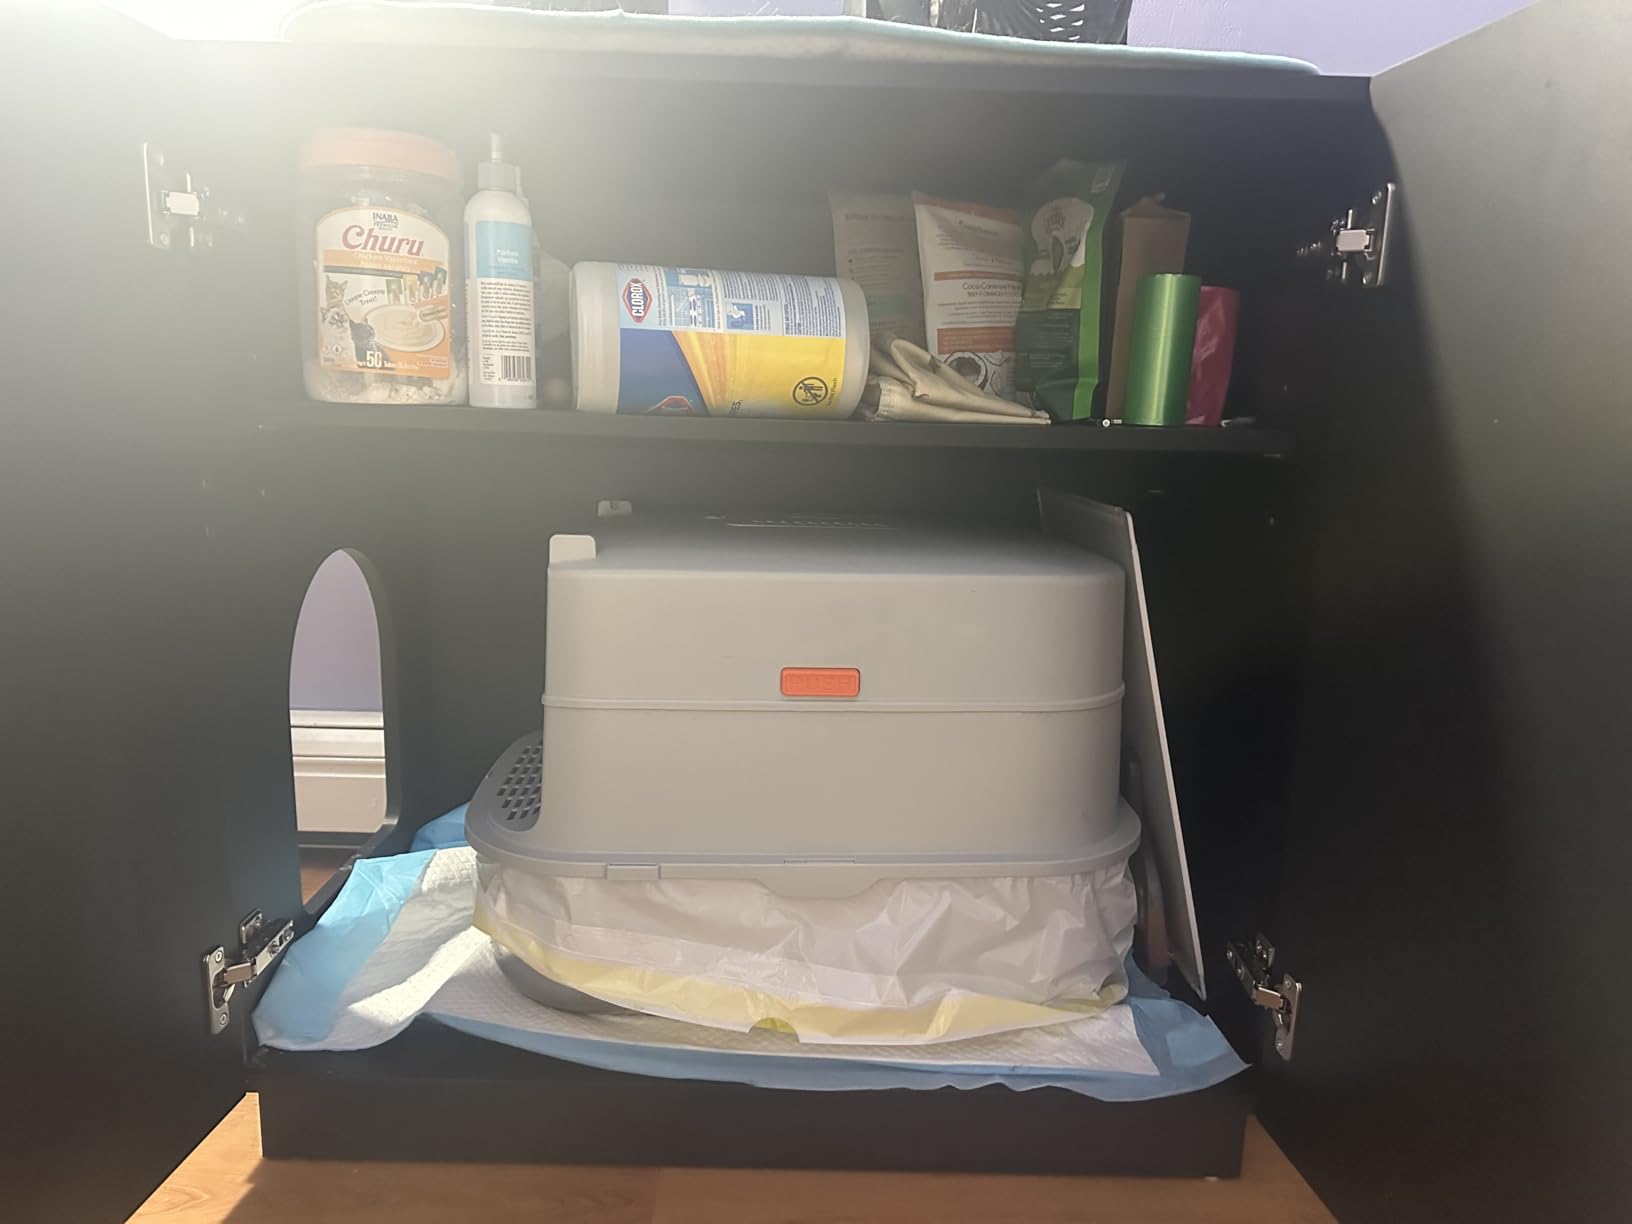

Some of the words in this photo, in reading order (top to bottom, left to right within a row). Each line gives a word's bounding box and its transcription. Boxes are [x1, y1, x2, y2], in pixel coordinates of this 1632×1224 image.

[372, 212, 399, 224] INABA
[342, 224, 424, 257] Churu
[631, 282, 645, 317] CLOROX
[366, 351, 382, 368] 50
